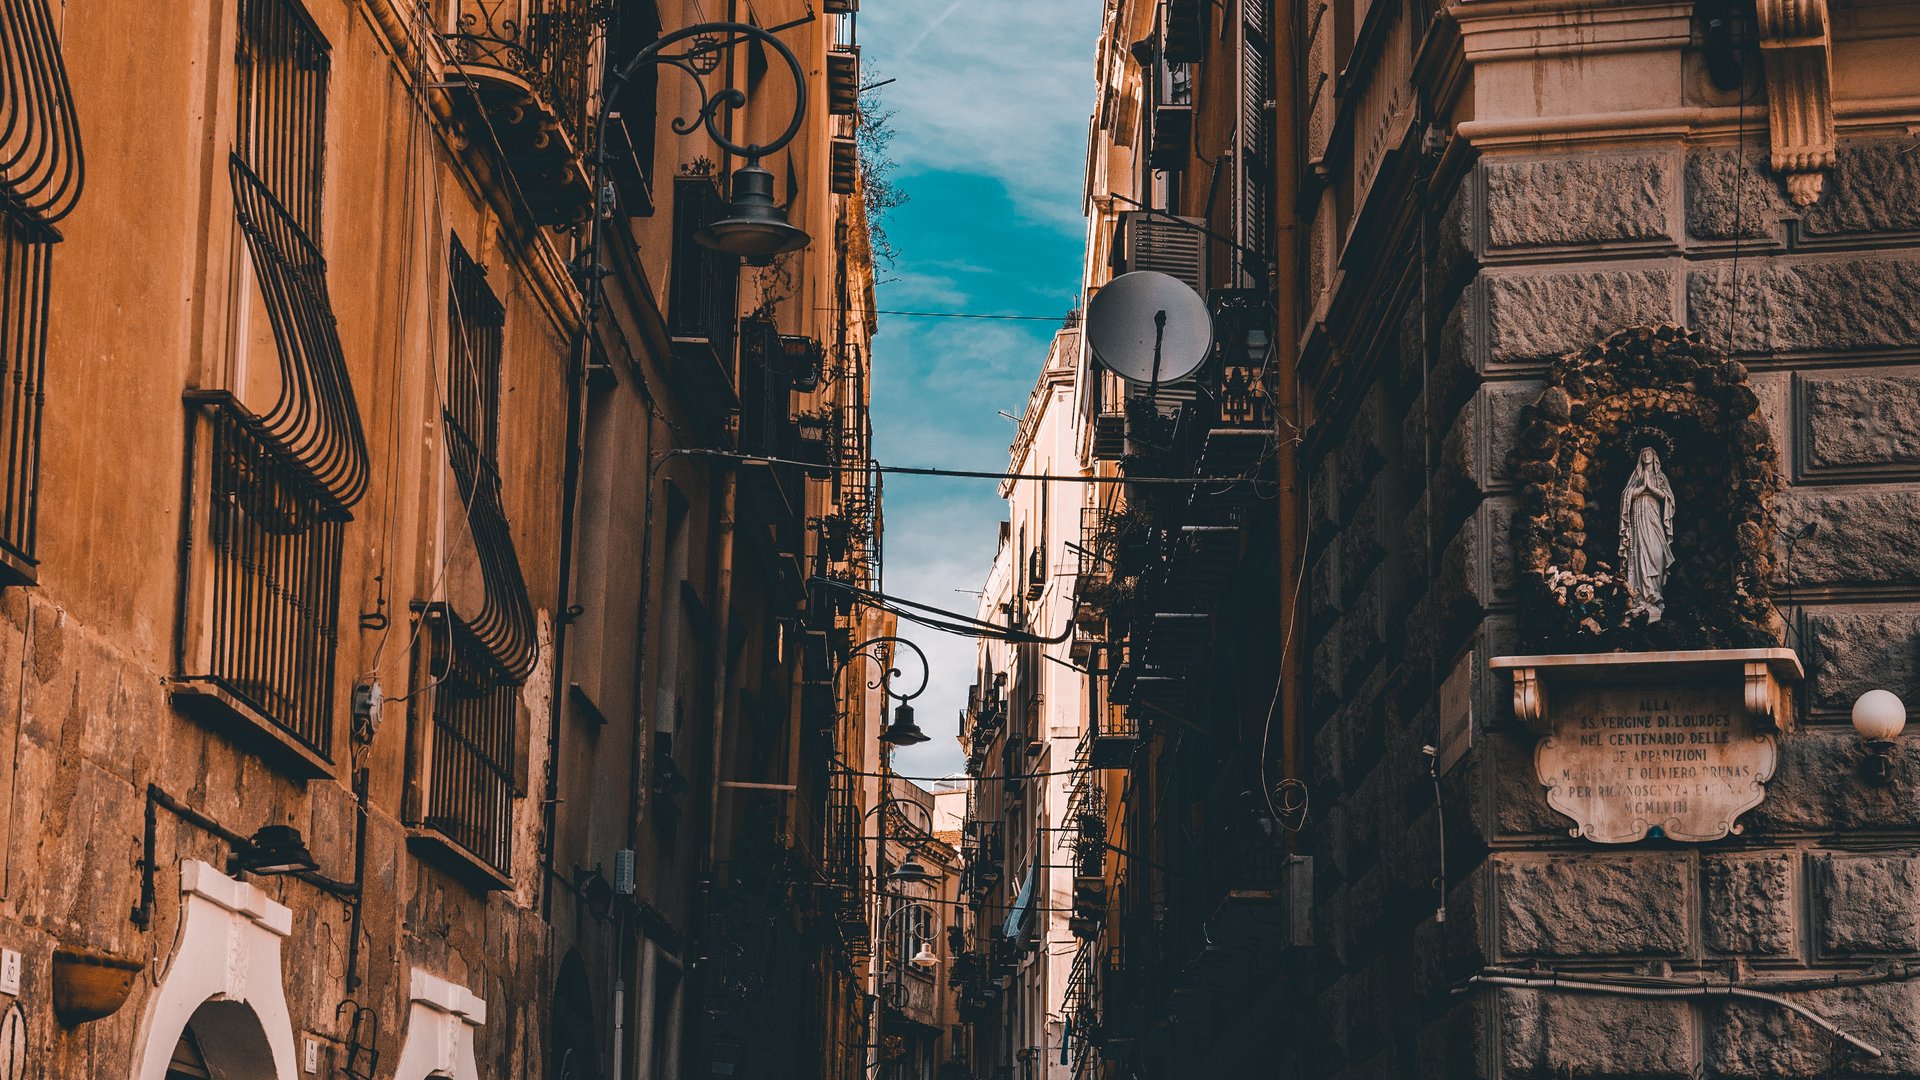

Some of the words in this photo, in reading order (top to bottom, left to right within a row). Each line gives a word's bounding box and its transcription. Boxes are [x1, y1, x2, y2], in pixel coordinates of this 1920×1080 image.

[1639, 698, 1669, 712] ALLA
[1600, 715, 1652, 729] VERGINE
[1675, 713, 1730, 728] LOURDES
[1580, 733, 1603, 746] NEL
[1609, 732, 1685, 746] CENTENARIO
[1690, 731, 1730, 744] DELLE
[1609, 750, 1626, 763] UE
[1633, 749, 1707, 763] APPARIZIONI
[1627, 767, 1634, 780] E
[1640, 766, 1696, 780] OLIVIERO
[1702, 765, 1750, 778] PRUNAS
[1569, 785, 1591, 798] PER
